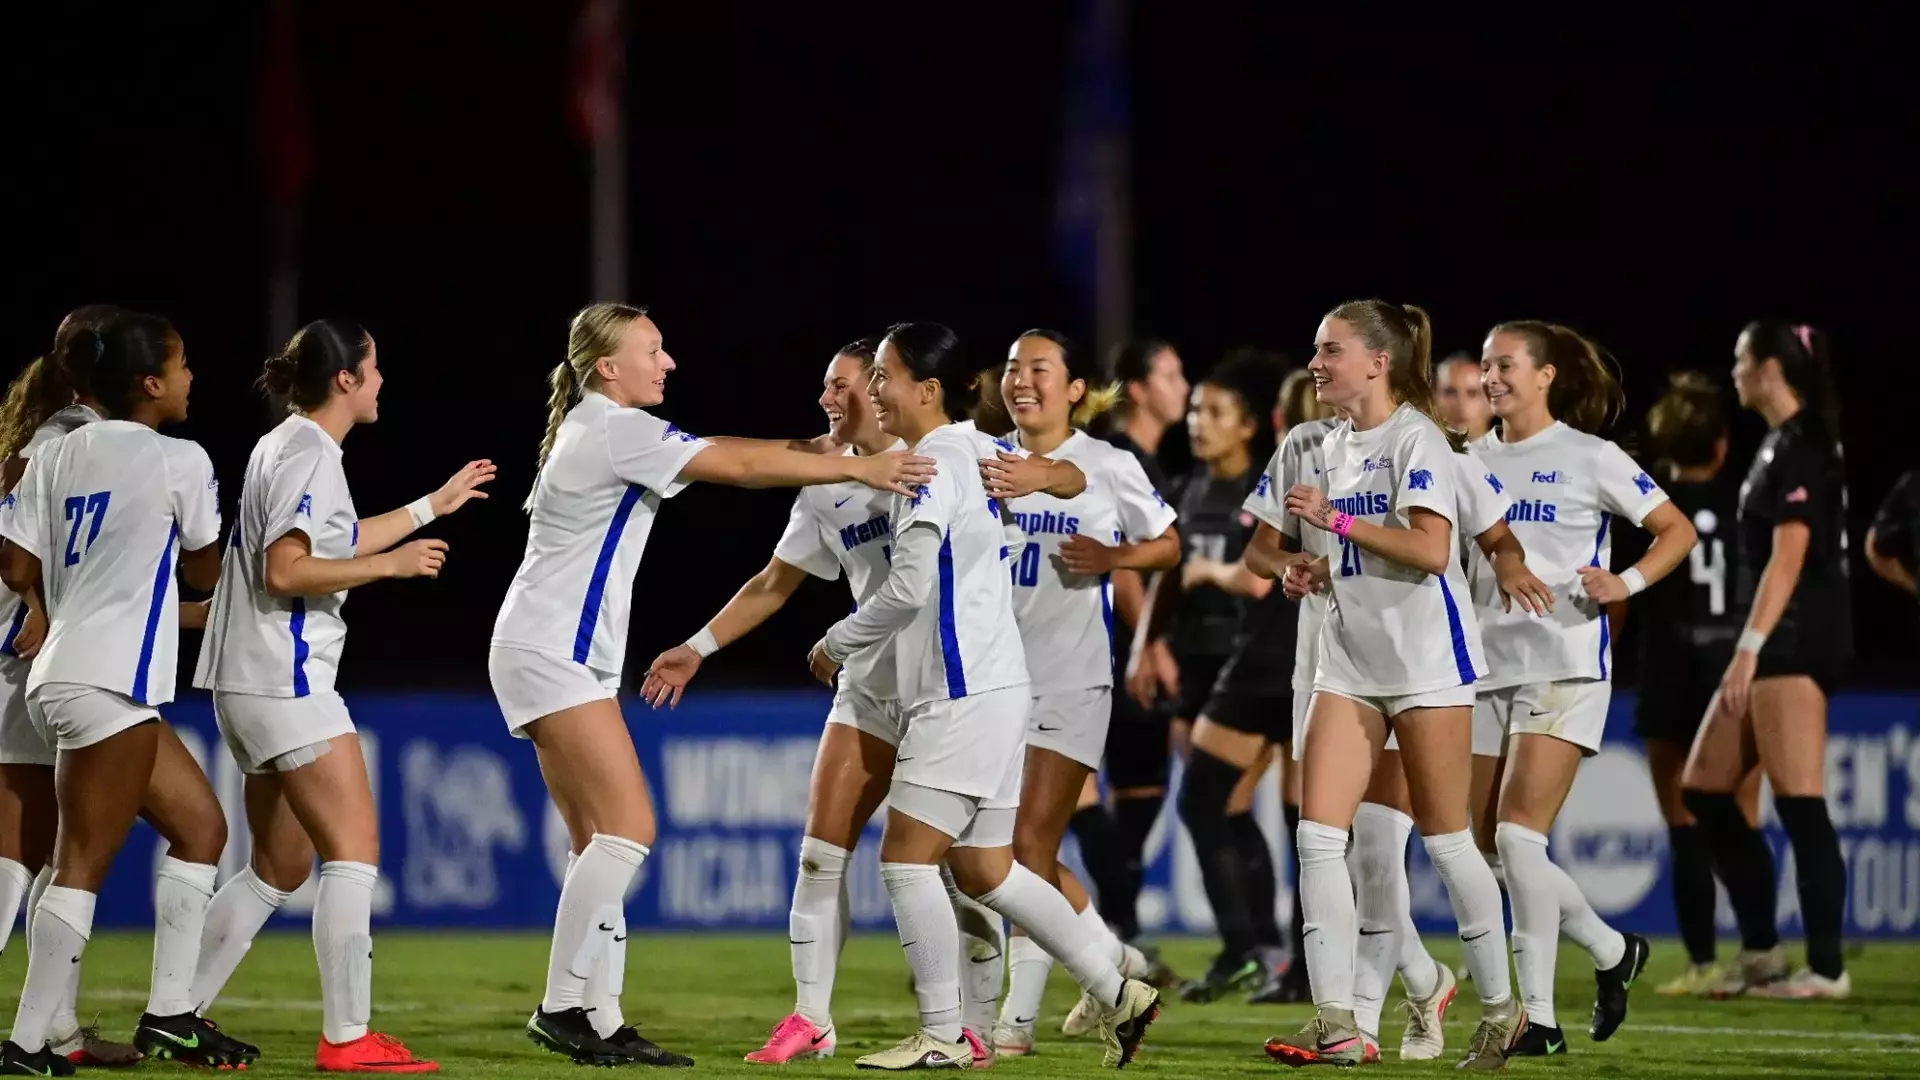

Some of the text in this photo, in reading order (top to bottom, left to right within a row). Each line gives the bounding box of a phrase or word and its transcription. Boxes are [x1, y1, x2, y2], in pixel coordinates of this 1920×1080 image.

[1331, 490, 1389, 516] mphis
[1504, 499, 1557, 525] phis
[64, 490, 112, 568] 27
[1015, 510, 1079, 536] mphis
[1011, 542, 1040, 587] 0
[1689, 537, 1726, 616] 4
